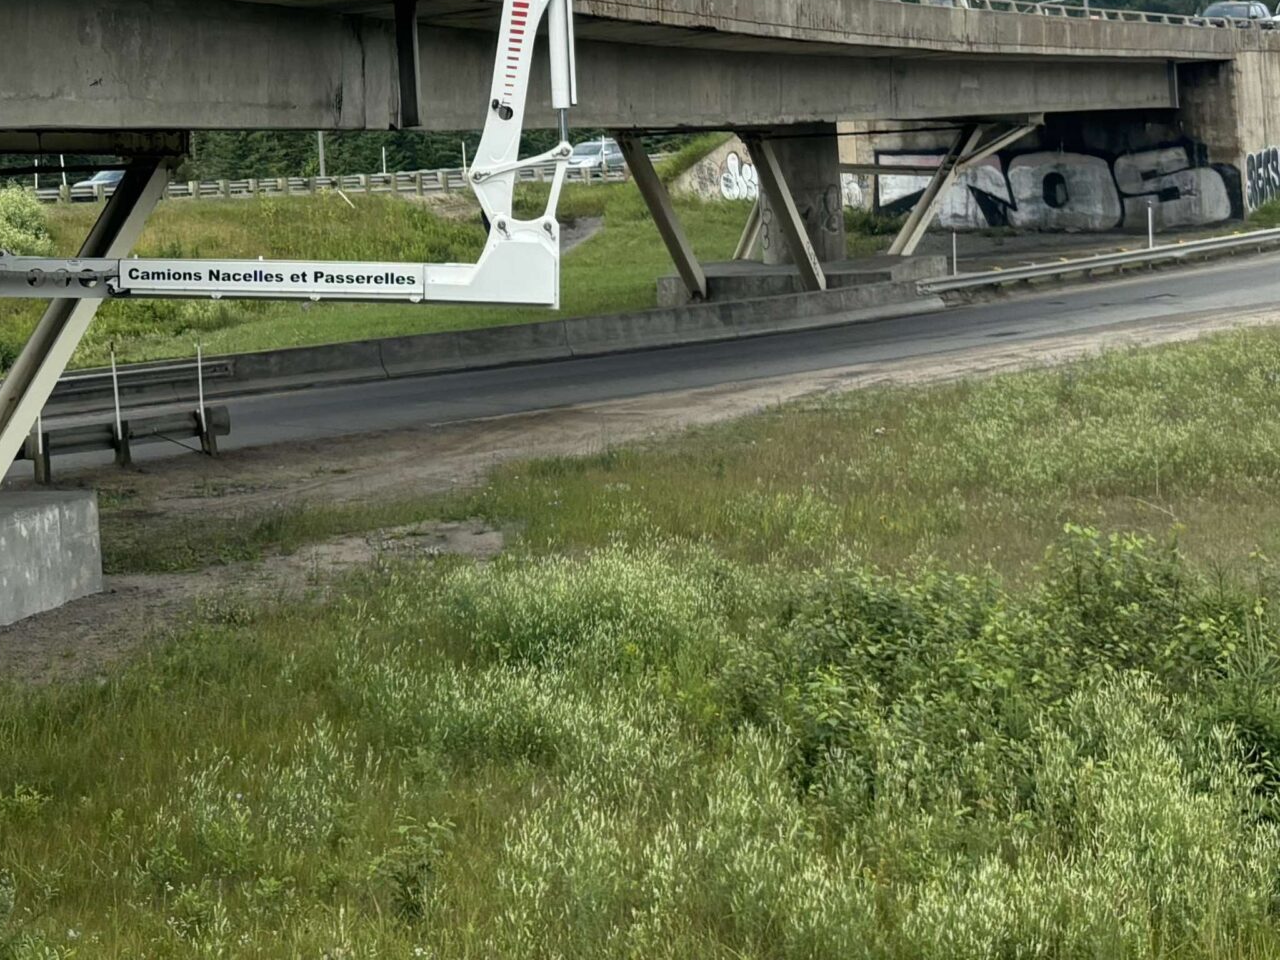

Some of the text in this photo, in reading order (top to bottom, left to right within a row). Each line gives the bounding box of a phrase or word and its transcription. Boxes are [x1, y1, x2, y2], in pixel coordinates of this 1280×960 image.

[128, 267, 417, 286] Camions Nacelles et Passerelles
